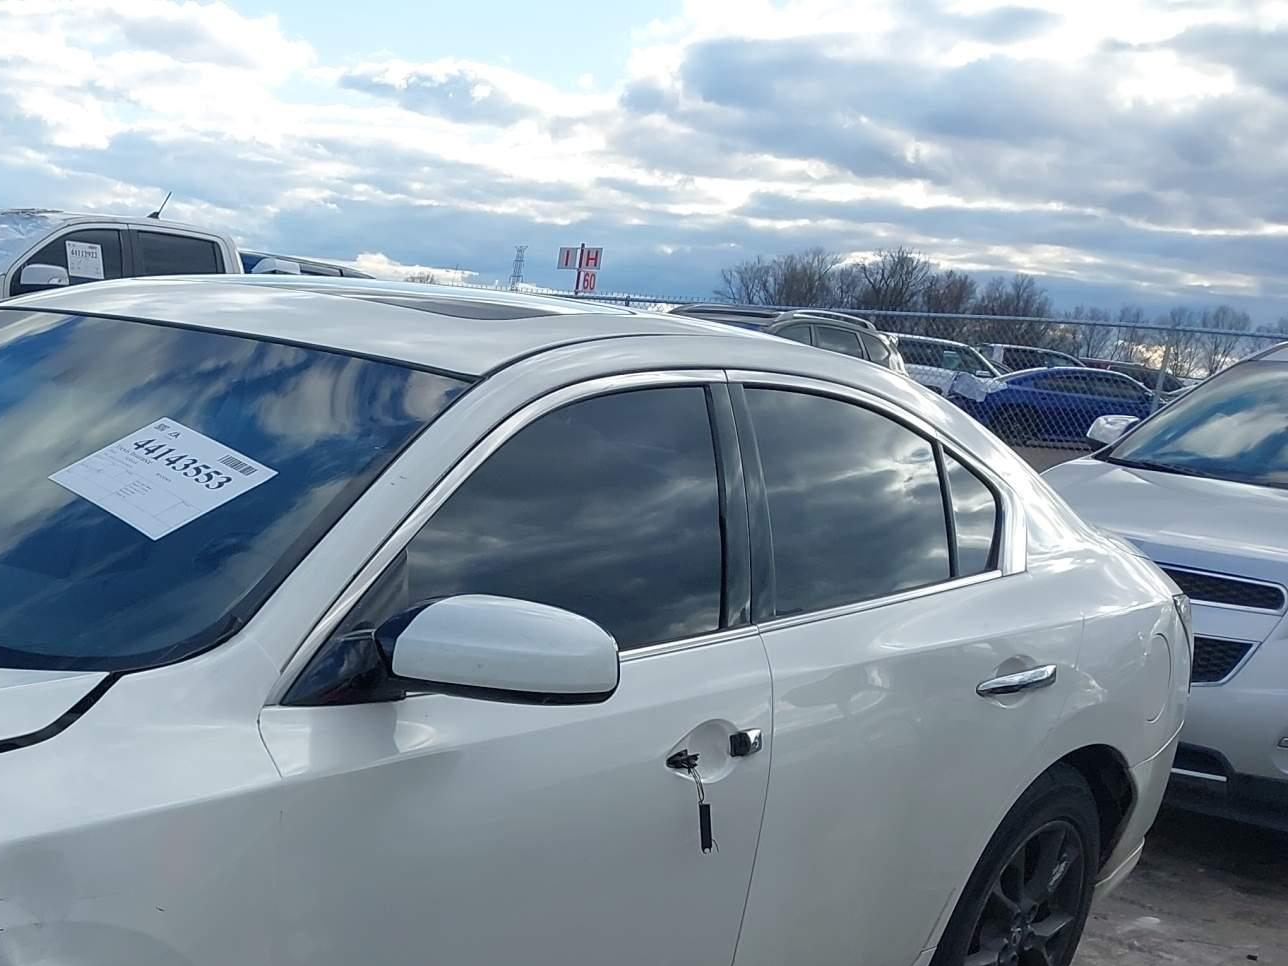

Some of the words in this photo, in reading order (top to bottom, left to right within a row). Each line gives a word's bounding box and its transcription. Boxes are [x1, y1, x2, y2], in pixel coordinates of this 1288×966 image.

[585, 250, 599, 267] H
[582, 272, 597, 291] 60
[133, 438, 233, 490] 44143553
